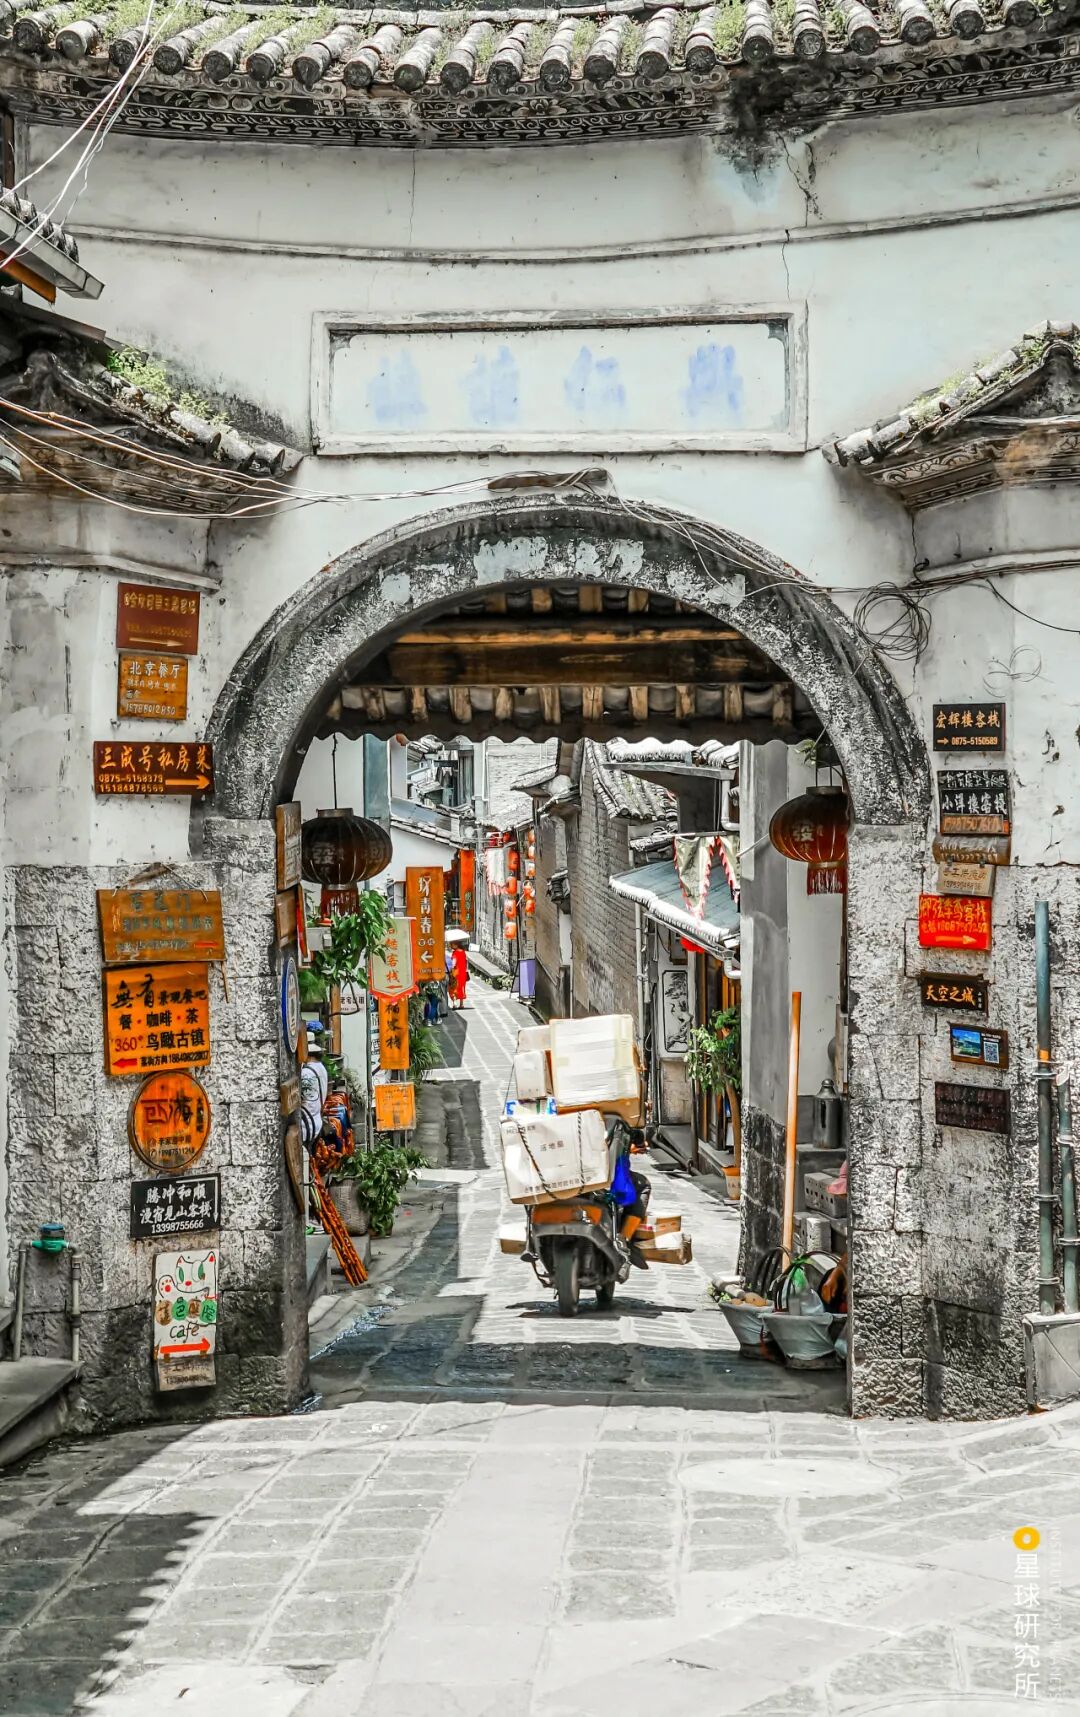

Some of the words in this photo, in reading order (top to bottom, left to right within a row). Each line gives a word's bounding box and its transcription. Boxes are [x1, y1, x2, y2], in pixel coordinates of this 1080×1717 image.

[129, 661, 180, 679] 北京餐厅
[100, 745, 211, 773] 三成号私房菜
[926, 985, 976, 1006] 天空之城
[146, 1029, 206, 1051] 鸟瞰古镇
